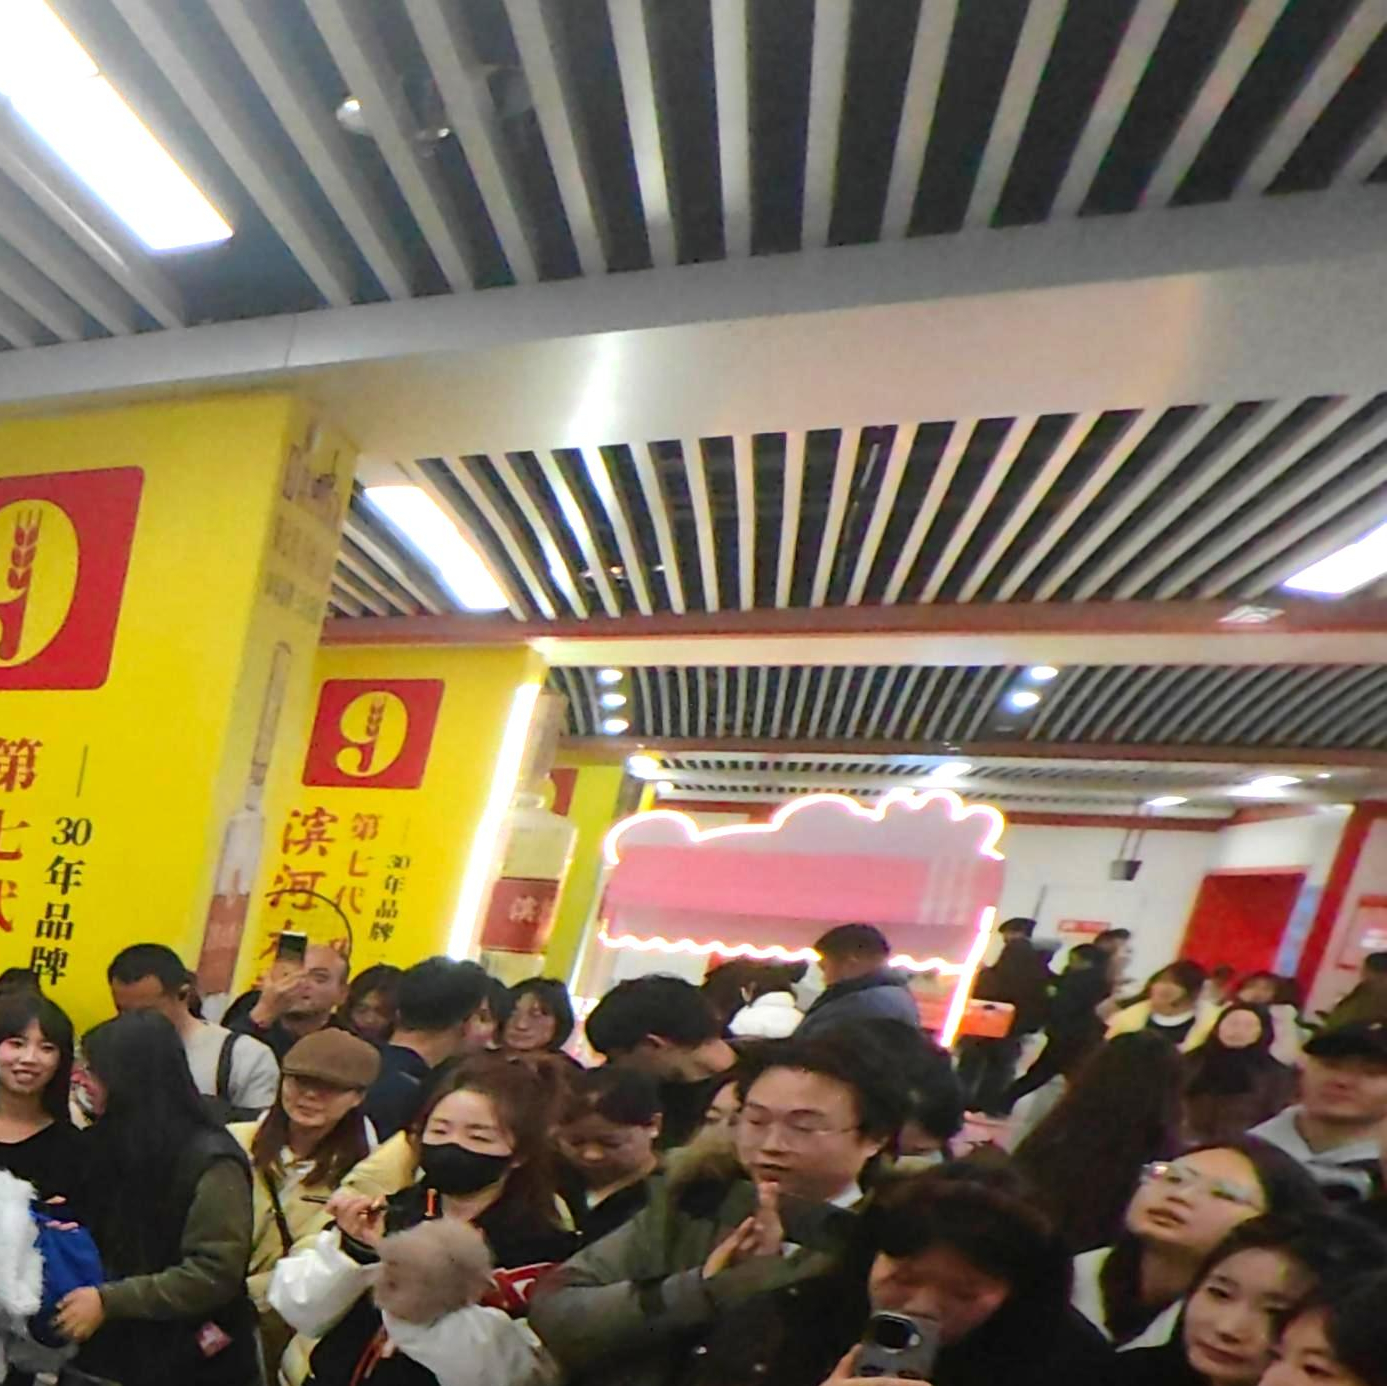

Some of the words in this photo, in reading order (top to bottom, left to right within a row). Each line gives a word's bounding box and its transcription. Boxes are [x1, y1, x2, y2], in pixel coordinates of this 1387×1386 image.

[334, 690, 408, 778] 9
[29, 816, 93, 986] 30年品牌
[334, 812, 381, 914] 第七代
[368, 855, 410, 942] 30年品牌
